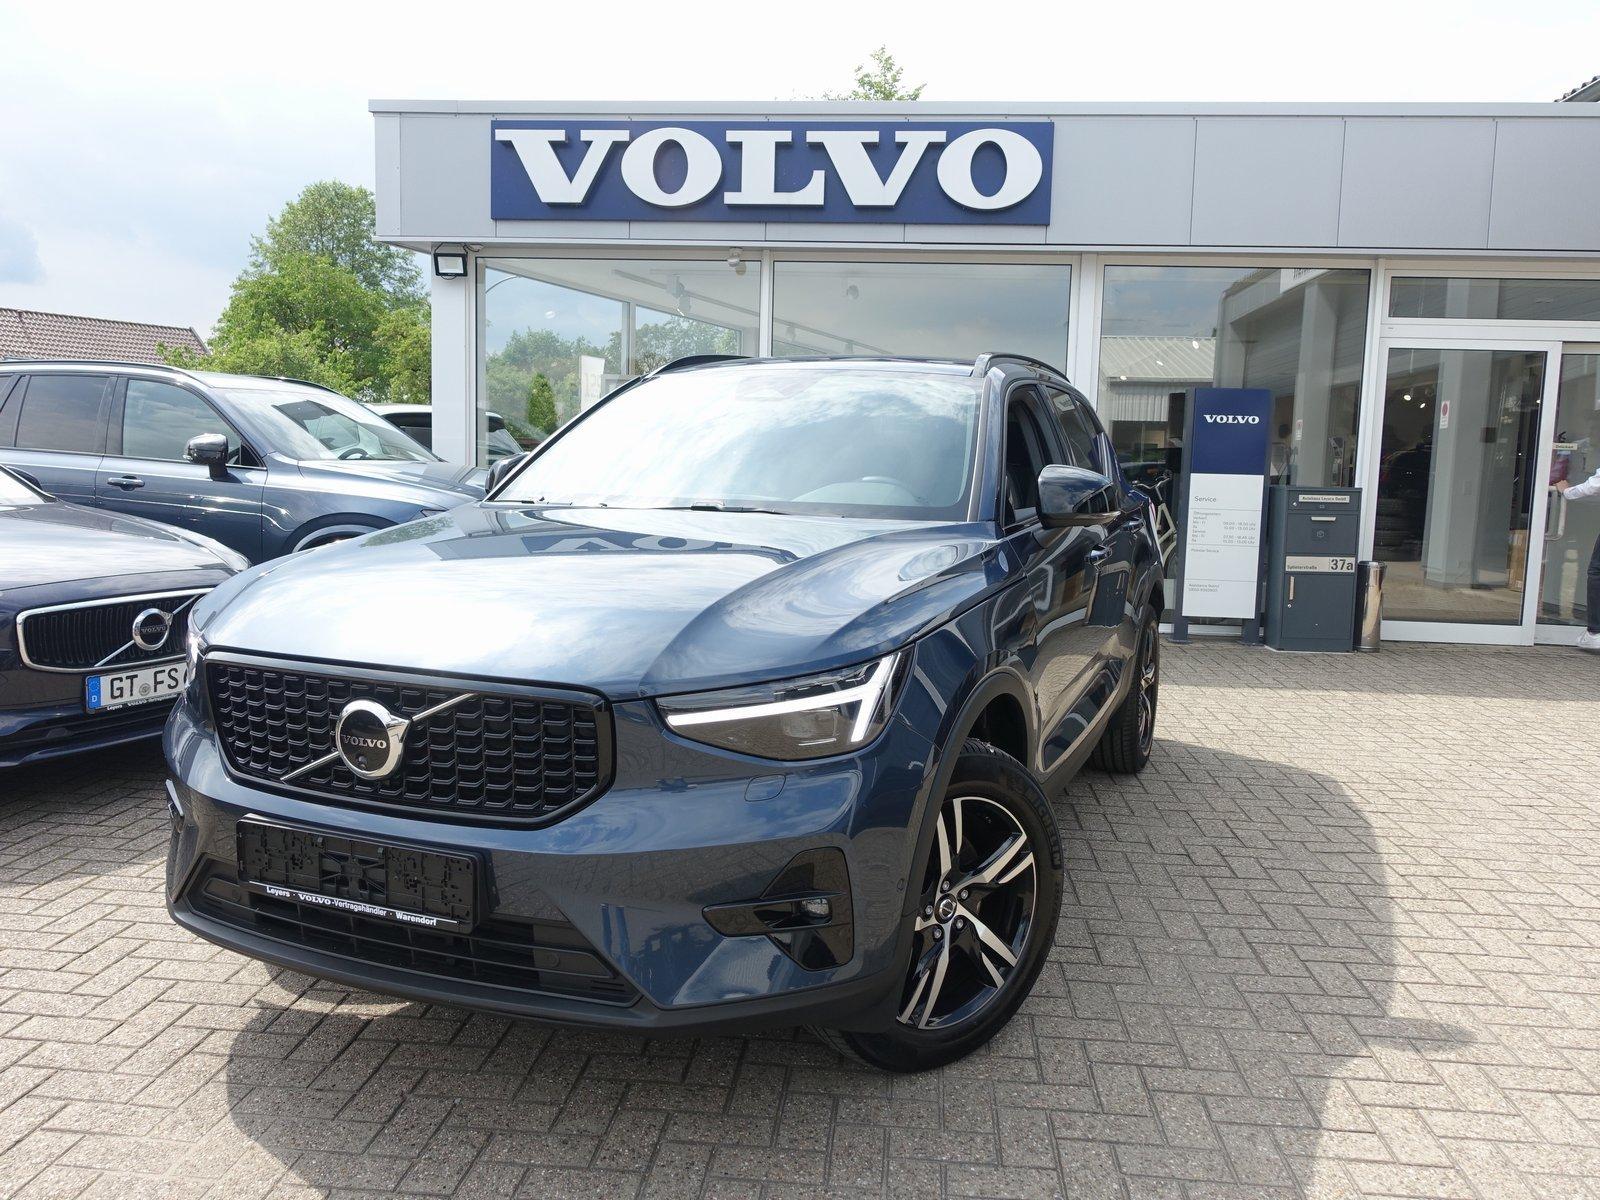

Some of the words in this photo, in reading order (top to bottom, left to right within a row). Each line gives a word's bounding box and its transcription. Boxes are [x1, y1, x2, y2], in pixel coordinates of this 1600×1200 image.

[494, 126, 1043, 210] VOLVO
[1203, 414, 1260, 424] VOLVO
[1194, 495, 1217, 503] Service
[1330, 558, 1354, 571] 37a
[110, 674, 138, 699] GT
[153, 667, 179, 693] FS
[340, 733, 387, 749] VOLVO
[266, 885, 291, 898] Leyers
[395, 911, 437, 927] Warendorf
